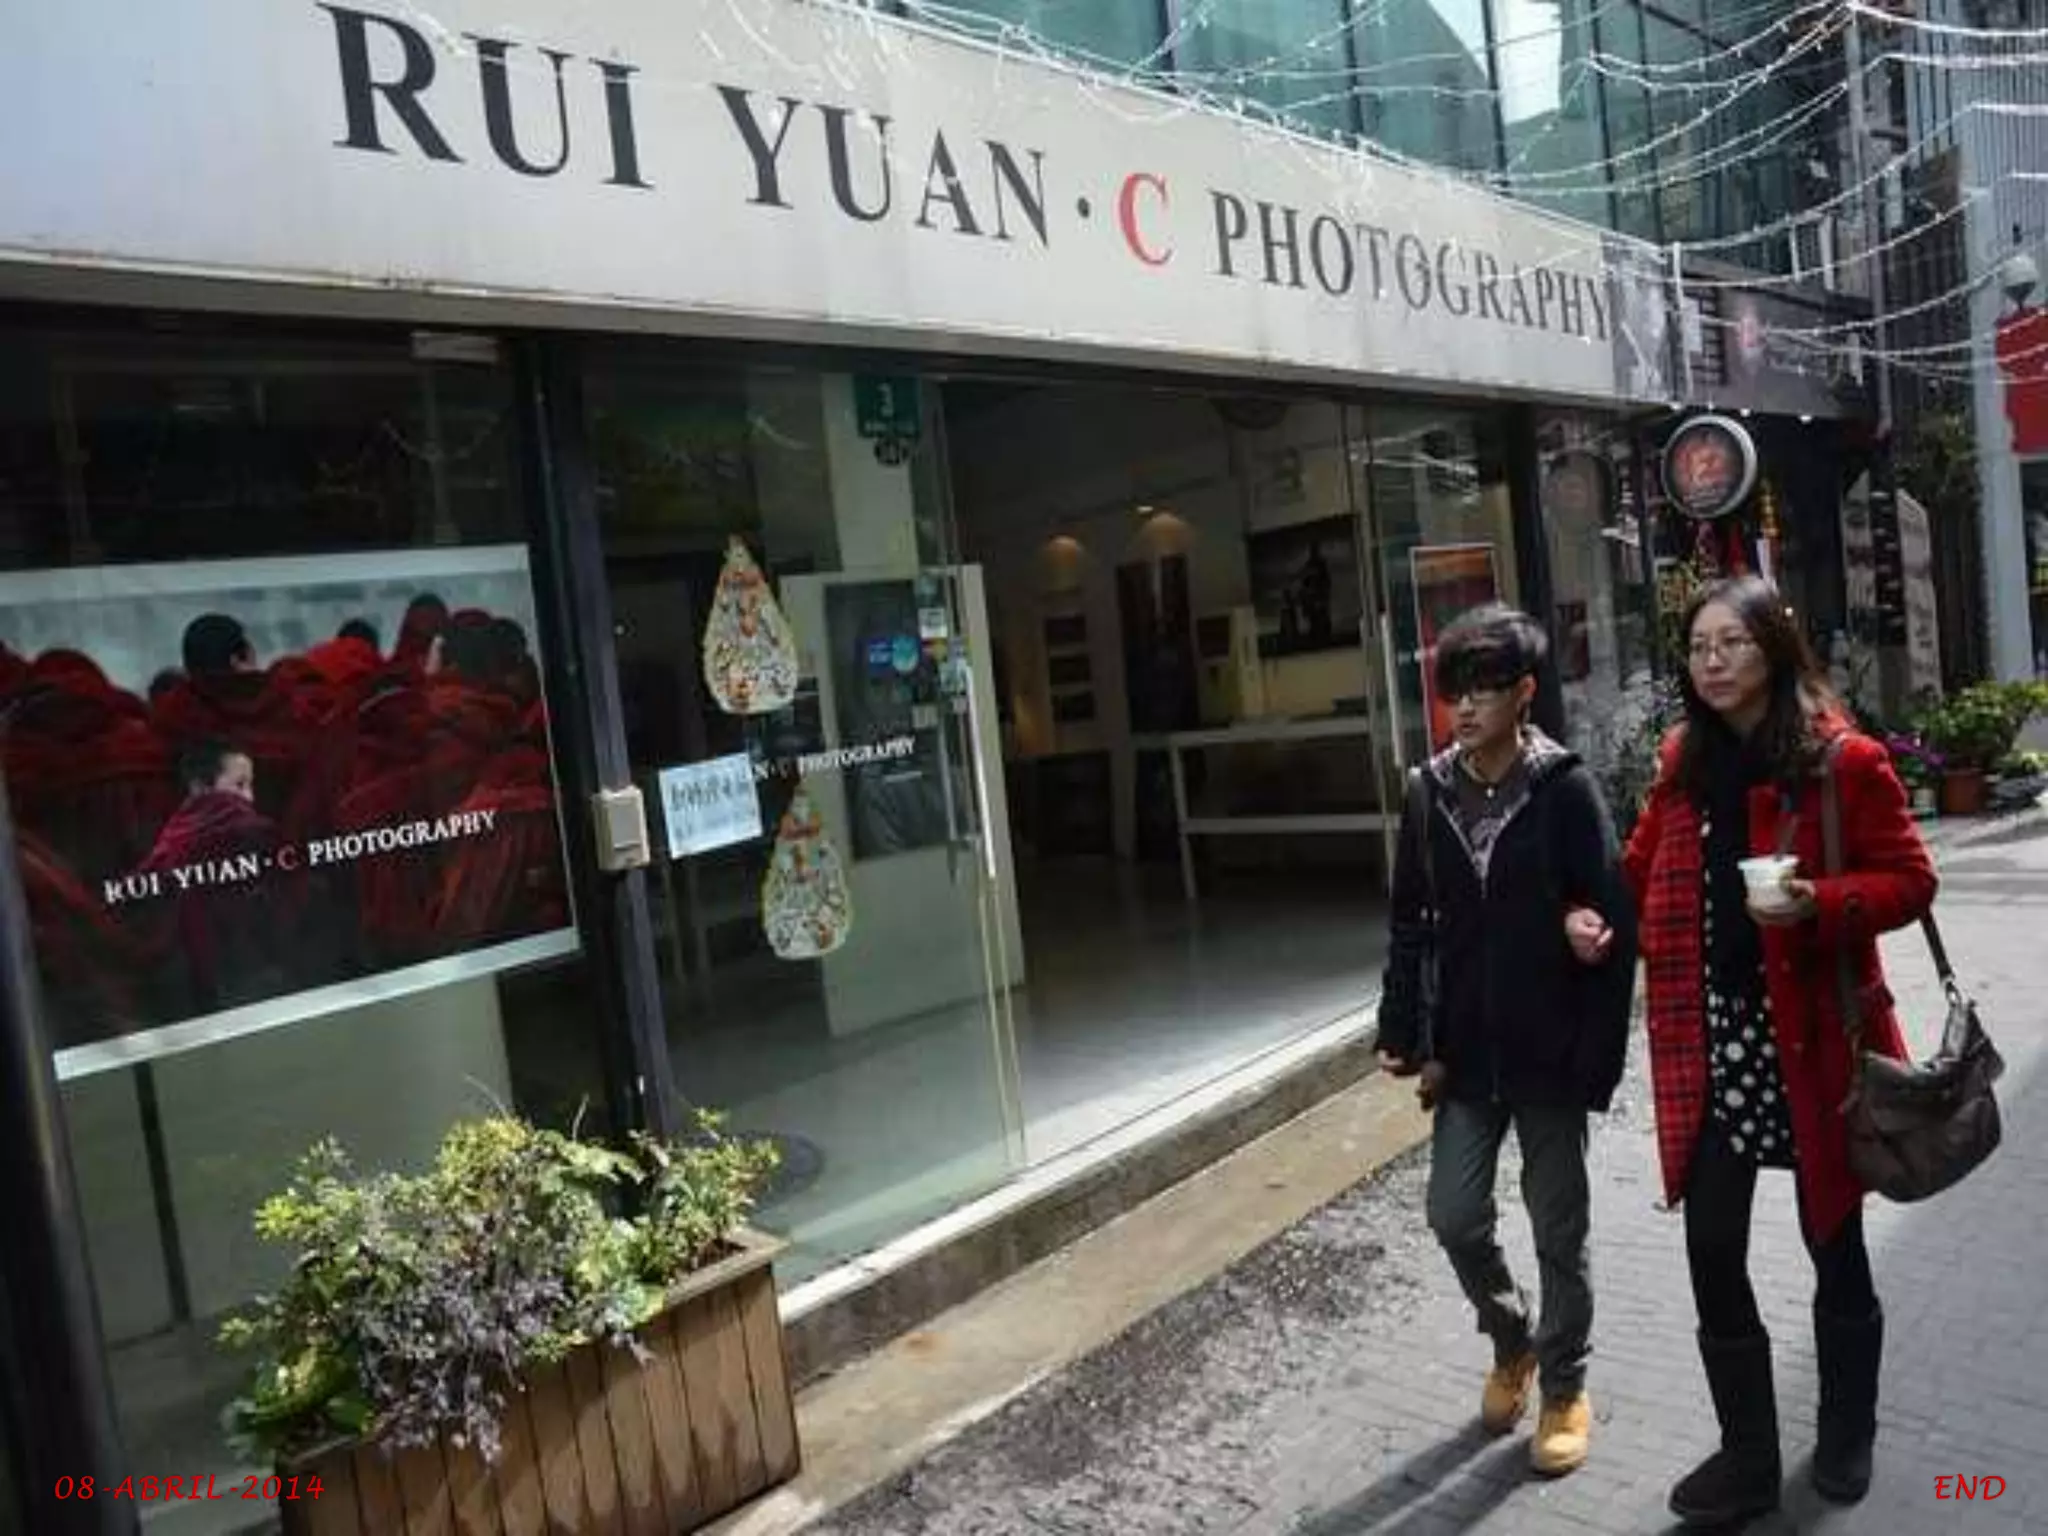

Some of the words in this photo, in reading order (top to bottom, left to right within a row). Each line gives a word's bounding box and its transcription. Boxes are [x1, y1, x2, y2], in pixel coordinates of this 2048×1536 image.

[316, 2, 655, 189] RUI
[717, 83, 1051, 249] YUAN
[1118, 172, 1174, 267] C
[1208, 189, 1617, 341] PHOTOGRAPHY
[103, 871, 161, 904] RUI
[173, 853, 261, 889] YUAN
[277, 845, 298, 871] C
[308, 809, 498, 866] PHOTOGRAPHY
